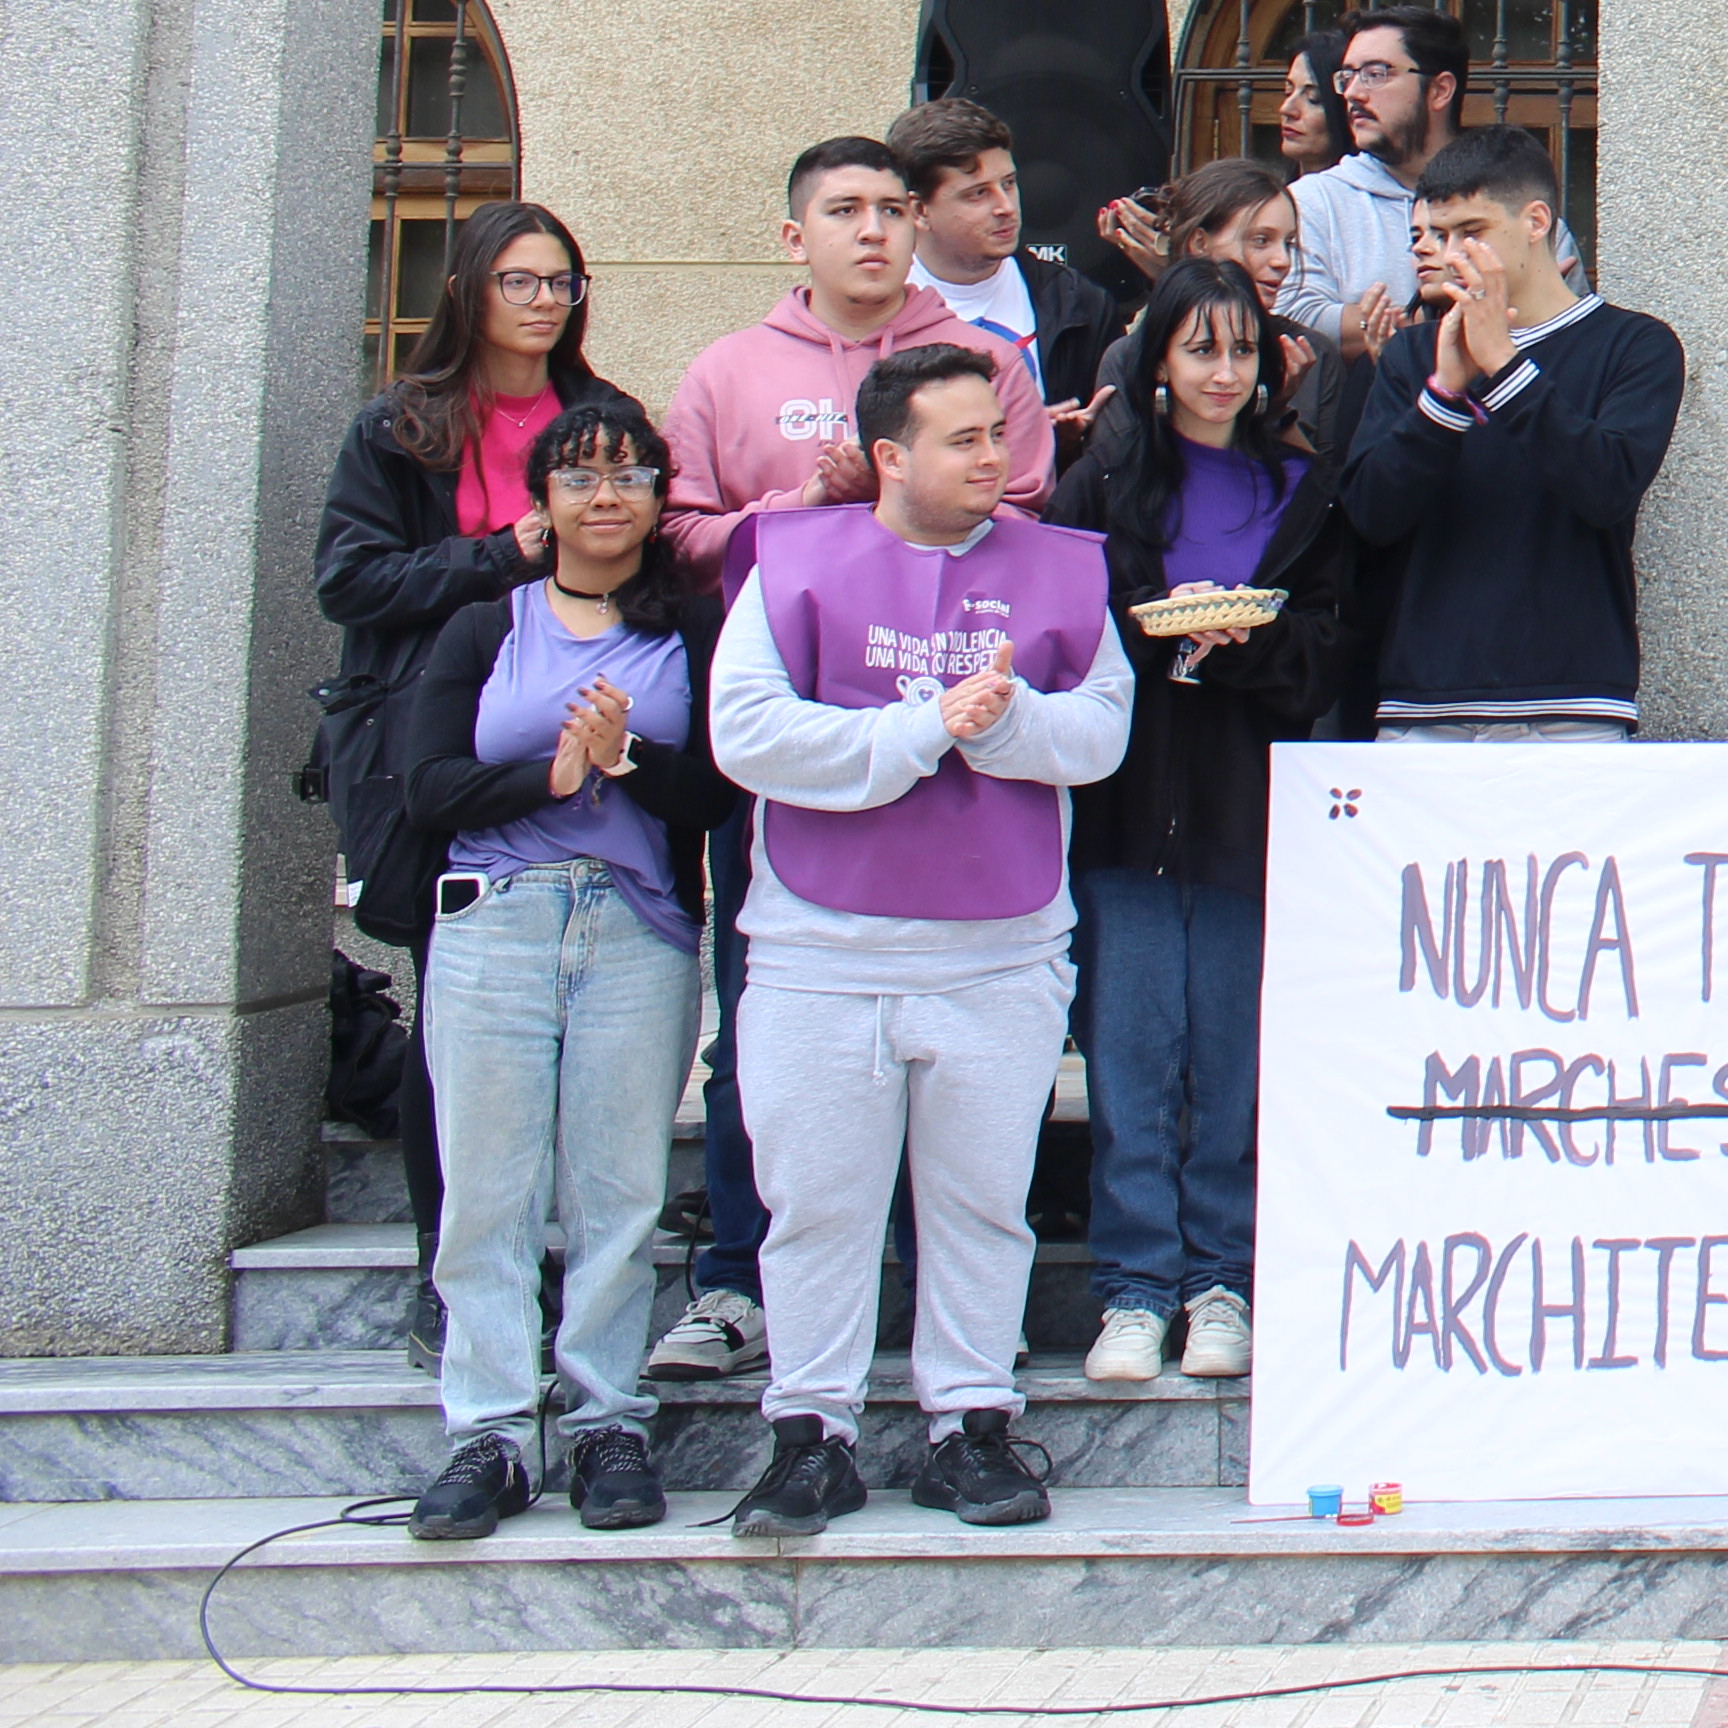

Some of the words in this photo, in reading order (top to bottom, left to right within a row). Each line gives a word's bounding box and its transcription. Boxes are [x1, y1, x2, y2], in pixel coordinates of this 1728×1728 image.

[868, 624, 897, 648] UNA
[899, 632, 930, 657] VIDA
[866, 646, 895, 669] UNA
[899, 650, 928, 675] VIDA
[948, 650, 999, 675] RESPET
[1399, 851, 1639, 1022] NUNCA
